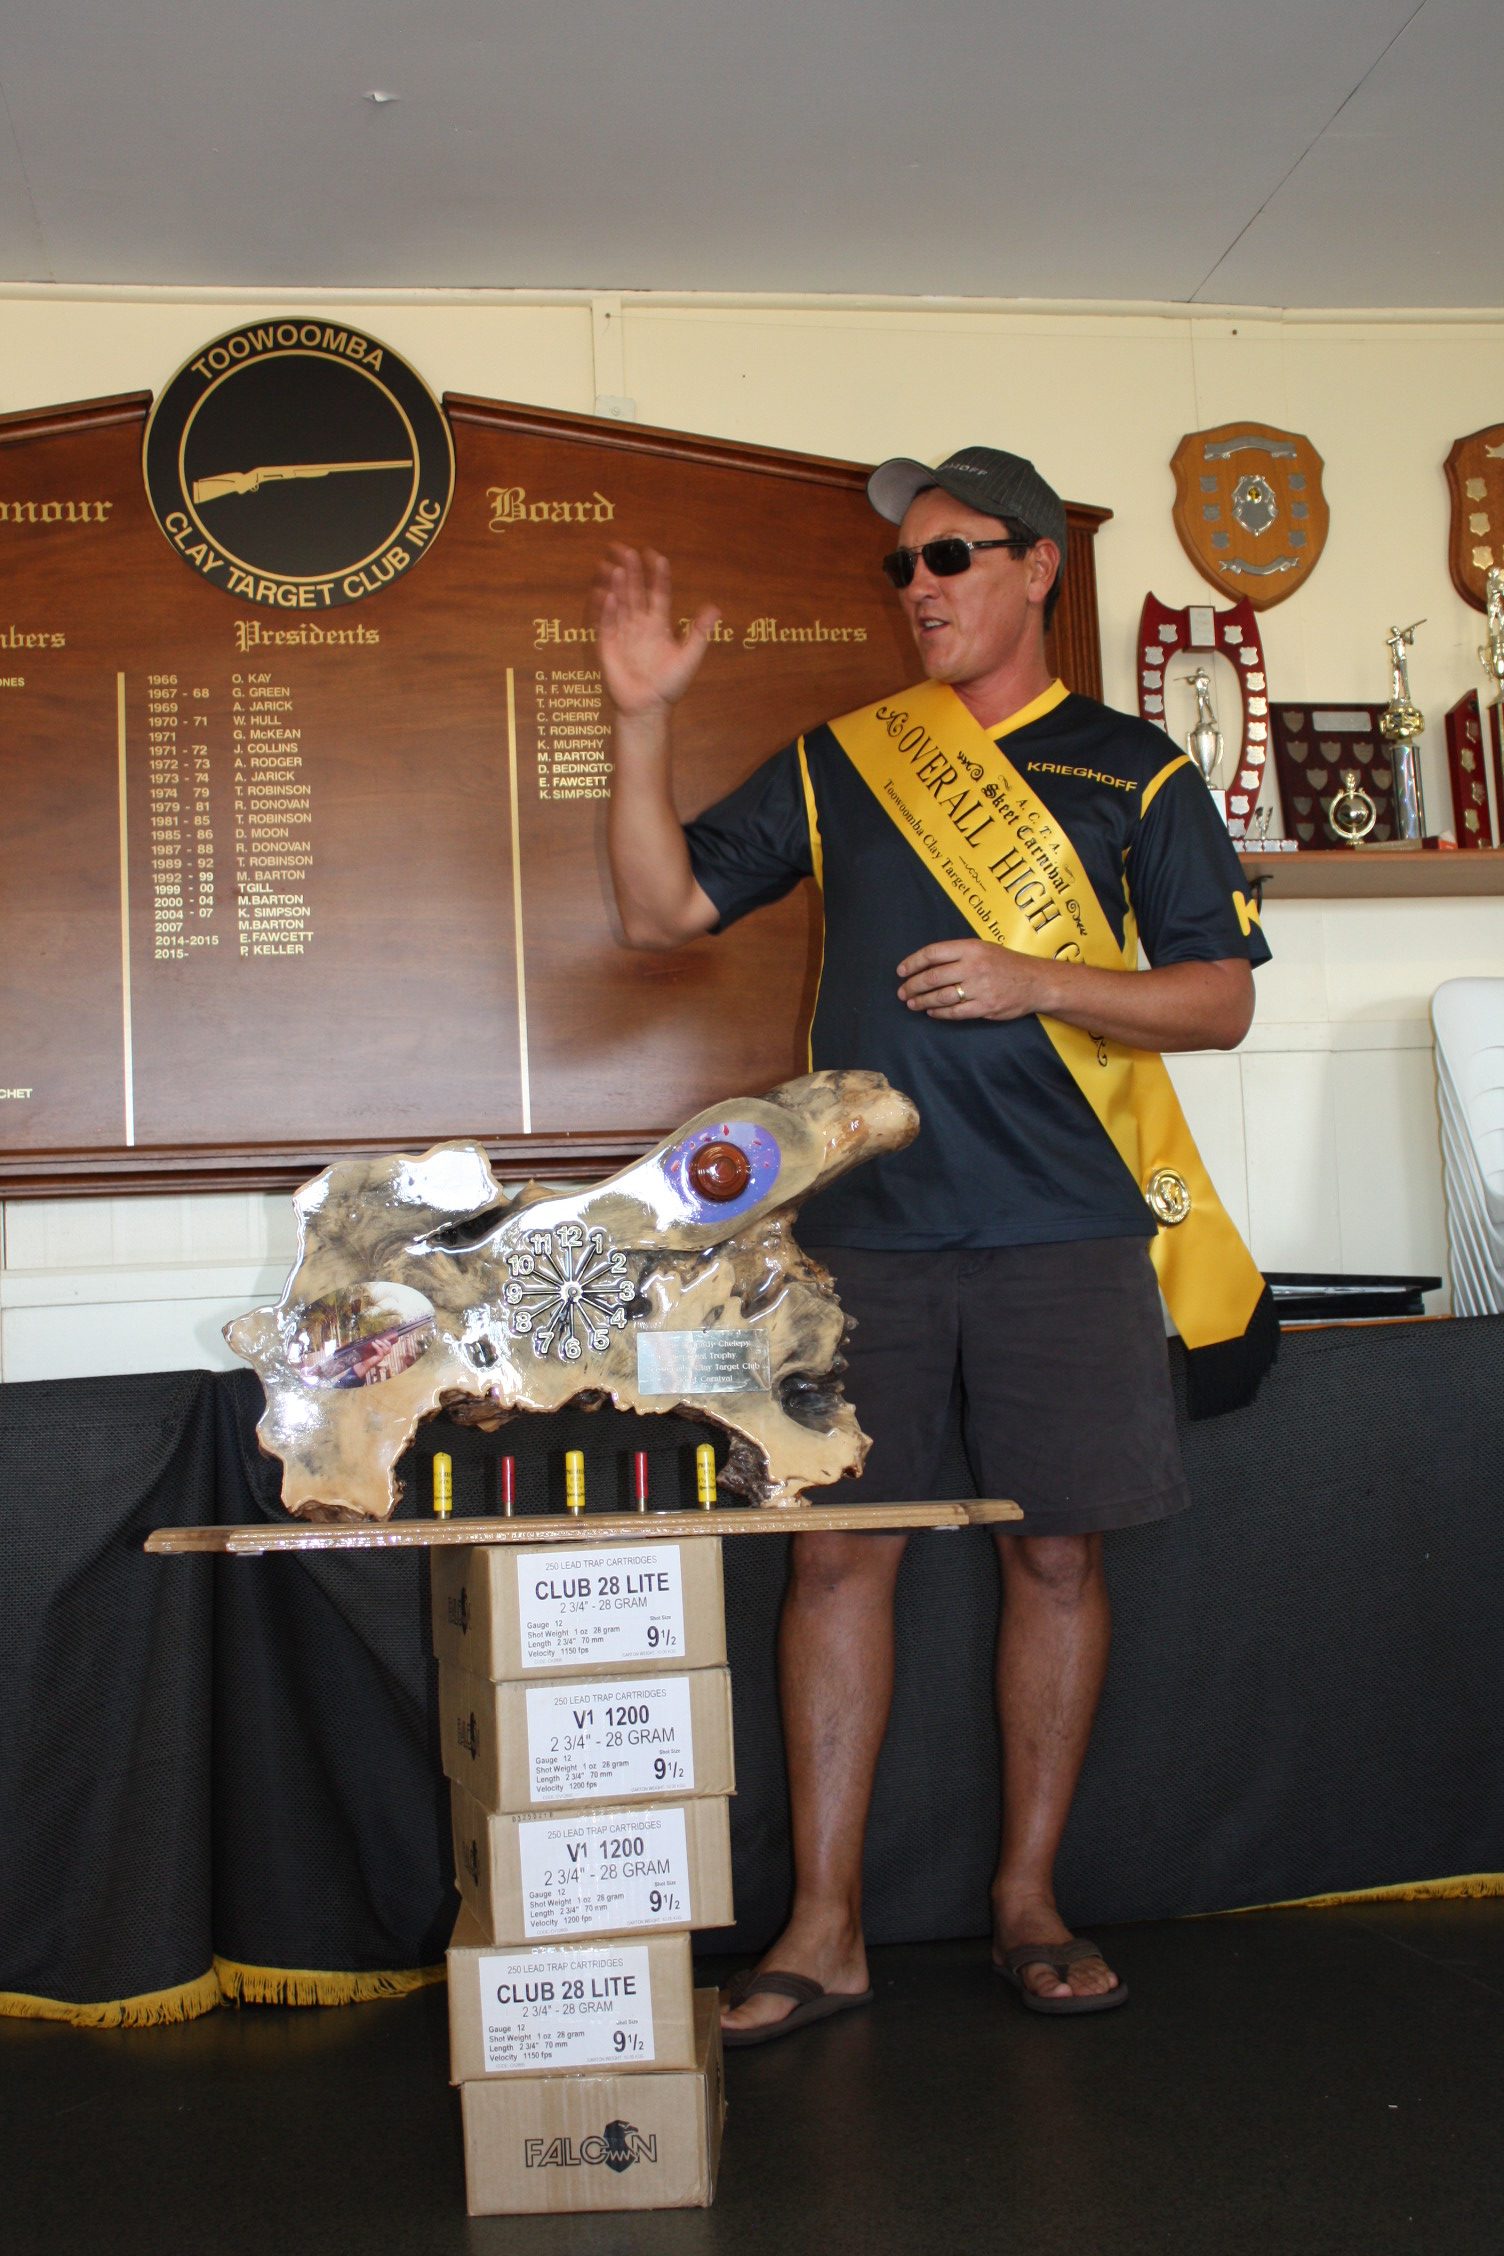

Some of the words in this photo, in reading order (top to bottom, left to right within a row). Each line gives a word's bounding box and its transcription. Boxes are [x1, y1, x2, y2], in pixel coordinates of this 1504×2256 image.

[191, 324, 384, 380] TOOWOOMBA
[486, 486, 616, 532] Board
[165, 511, 224, 573] CLAY
[222, 566, 335, 607] TARGET
[343, 546, 411, 598] CLUB
[405, 499, 441, 547] INC
[234, 620, 380, 652] Presidents
[743, 617, 868, 650] Members
[147, 674, 178, 685] 1966
[231, 673, 244, 684] O.
[248, 673, 272, 683] KAY
[535, 671, 548, 680] G.
[535, 685, 548, 694] R.
[563, 684, 602, 694] WELLS
[148, 703, 178, 713] 1969
[233, 702, 245, 712] A.
[249, 700, 293, 712] JARICK
[537, 698, 545, 708] T.
[549, 698, 602, 708] HOPKINS
[537, 712, 548, 722] C.
[552, 712, 600, 721] CHERRY
[148, 731, 176, 742] 1971
[233, 730, 246, 739] G.
[250, 729, 301, 739] McKEAN
[538, 726, 545, 736] T.
[550, 725, 611, 735] ROBINSON
[537, 752, 551, 762] M.
[554, 751, 604, 761] BARTON
[538, 765, 549, 774] D.
[552, 763, 615, 773] BEDINGTO
[1027, 761, 1138, 792] KRIEGHOFF
[539, 777, 550, 787] E.
[553, 776, 607, 787] FAWCETT
[540, 789, 551, 799] K.
[553, 789, 611, 799] SIMPSON
[899, 725, 995, 849] OVERALL
[988, 846, 1062, 935] HIGH
[981, 783, 1019, 825] Skeet
[1016, 825, 1071, 894] Carnival
[883, 778, 924, 837] Toowoomba
[923, 834, 943, 860] Clay
[941, 857, 970, 895] Target
[968, 894, 992, 922] Club
[155, 910, 184, 920] 2004
[199, 908, 214, 918] 07
[238, 908, 250, 918] K.
[254, 907, 311, 918] SIMPSON
[155, 922, 183, 932] 2007
[155, 936, 219, 946] 2014-2015
[240, 933, 251, 943] E.
[252, 931, 314, 942] FAWCETT
[155, 949, 189, 959] 2015-
[240, 945, 248, 957] P.
[253, 944, 304, 955] KELLER
[530, 1233, 552, 1255] 11
[557, 1225, 583, 1248] 12
[591, 1233, 603, 1254] 1
[508, 1254, 535, 1276] 10
[611, 1253, 627, 1274] 2
[505, 1283, 523, 1304] 9
[619, 1280, 636, 1301] 3
[515, 1311, 533, 1333] 8
[609, 1307, 628, 1329] 4
[538, 1331, 555, 1354] 7
[564, 1337, 582, 1359] 6
[592, 1329, 610, 1351] 5
[545, 1562, 559, 1571] 250
[560, 1560, 582, 1570] LEAD
[584, 1558, 604, 1568] TRAP
[607, 1555, 657, 1566] CARTRIDGES
[535, 1577, 591, 1600] CLUB
[598, 1576, 620, 1596] 28
[626, 1572, 670, 1594] LITE
[560, 1602, 565, 1613] 2
[569, 1601, 589, 1613] 3/4"
[599, 1599, 612, 1610] 28
[614, 1596, 648, 1610] GRAM
[527, 1621, 550, 1630] Gauge
[528, 1631, 543, 1639] Shot
[545, 1630, 569, 1639] Weight
[593, 1626, 602, 1634] 28
[603, 1626, 620, 1635] gram
[528, 1649, 555, 1658] Velocity
[578, 1647, 589, 1655] fps
[554, 1698, 568, 1706] 250
[569, 1695, 590, 1705] LEAD
[592, 1694, 614, 1703] TRAP
[615, 1689, 667, 1701] CARTRIDGES
[573, 1709, 594, 1729] V1
[605, 1704, 650, 1727] 1200
[550, 1736, 559, 1752] 2
[563, 1733, 591, 1750] 3/4"
[606, 1731, 623, 1747] 28
[628, 1727, 675, 1745] GRAM
[547, 1831, 562, 1840] 250
[563, 1828, 584, 1838] LEAD
[586, 1826, 607, 1836] TRAP
[609, 1820, 662, 1833] CARTRIDGES
[567, 1842, 588, 1863] V1
[599, 1837, 645, 1859] 1200
[544, 1870, 553, 1886] 2
[558, 1867, 585, 1885] 3/4"
[600, 1864, 618, 1880] 28
[622, 1859, 671, 1878] GRAM
[507, 1966, 521, 1974] 250
[523, 1964, 545, 1973] LEAD
[547, 1963, 569, 1972] TRAP
[571, 1958, 624, 1970] CARTRIDGES
[497, 1981, 555, 2004] CLUB
[561, 1980, 584, 1999] 28
[591, 1975, 636, 1998] LITE
[523, 2006, 528, 2017] 2
[532, 2004, 552, 2017] 3/4"
[563, 2003, 576, 2015] 28
[578, 2000, 613, 2014] GRAM
